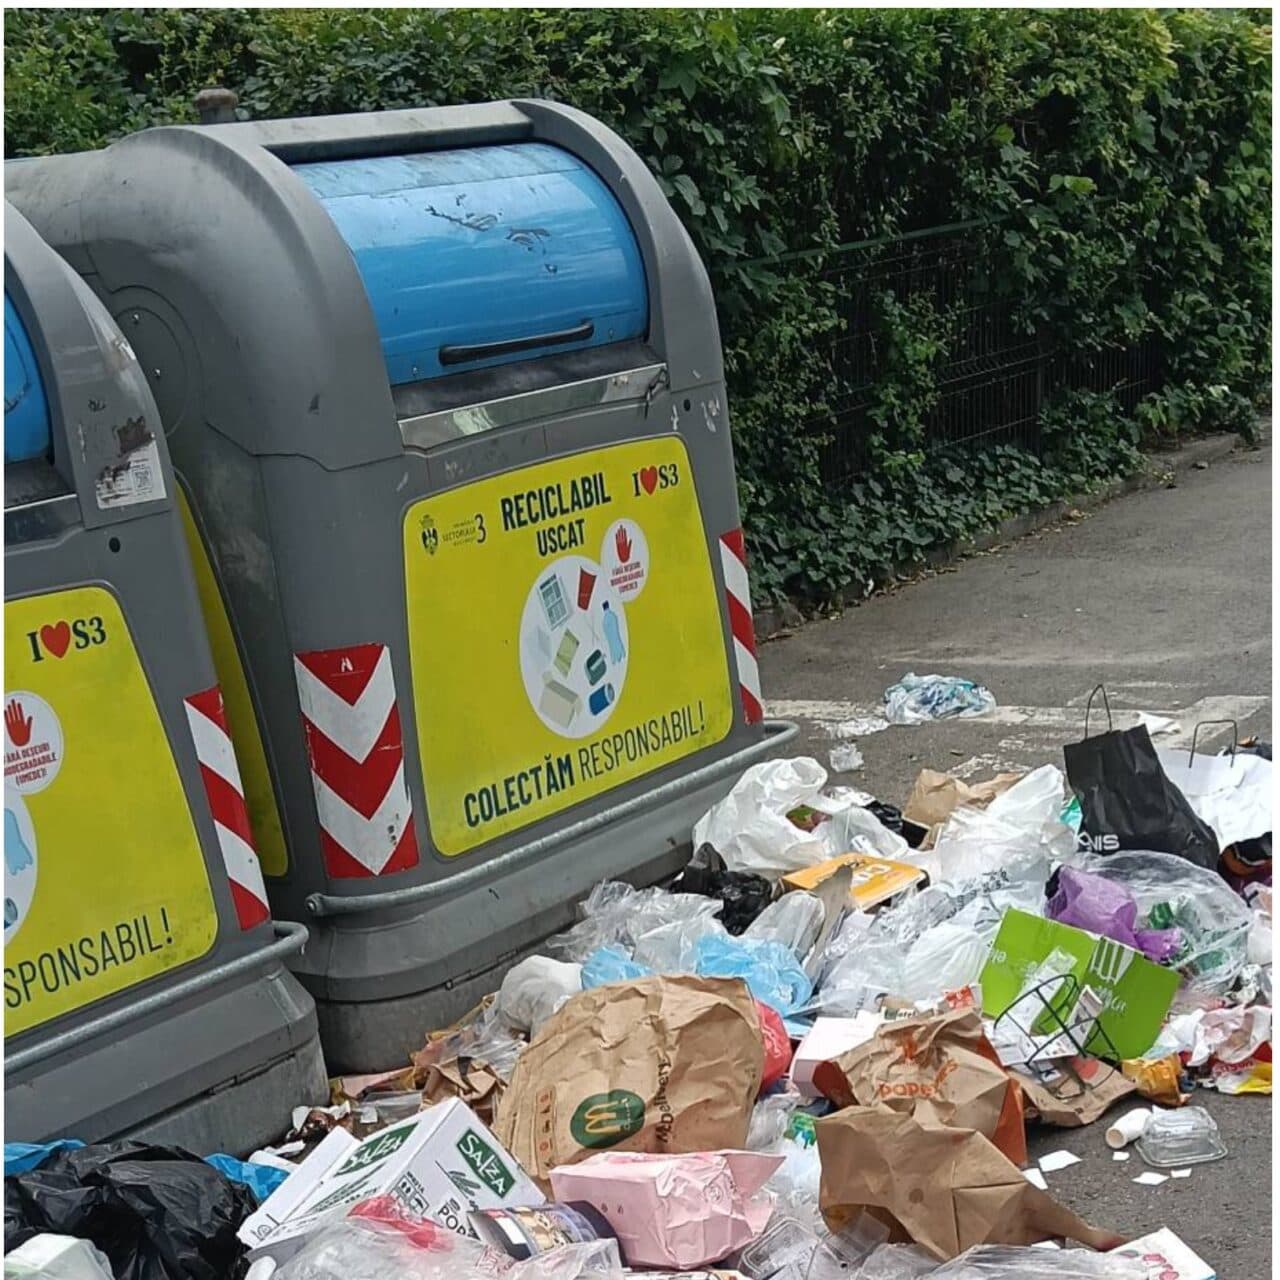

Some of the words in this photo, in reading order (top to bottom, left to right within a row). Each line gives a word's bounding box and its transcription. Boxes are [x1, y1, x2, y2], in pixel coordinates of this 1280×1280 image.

[500, 471, 612, 532] RECICLABIL
[632, 472, 642, 497] I
[659, 463, 679, 489] S3
[474, 513, 486, 544] 3
[537, 519, 586, 557] USCAT
[26, 631, 42, 662] I
[72, 616, 107, 650] S3
[464, 754, 576, 828] COLECTĂM
[579, 700, 706, 783] RESPONSABIL!
[463, 1134, 506, 1195] SALZA
